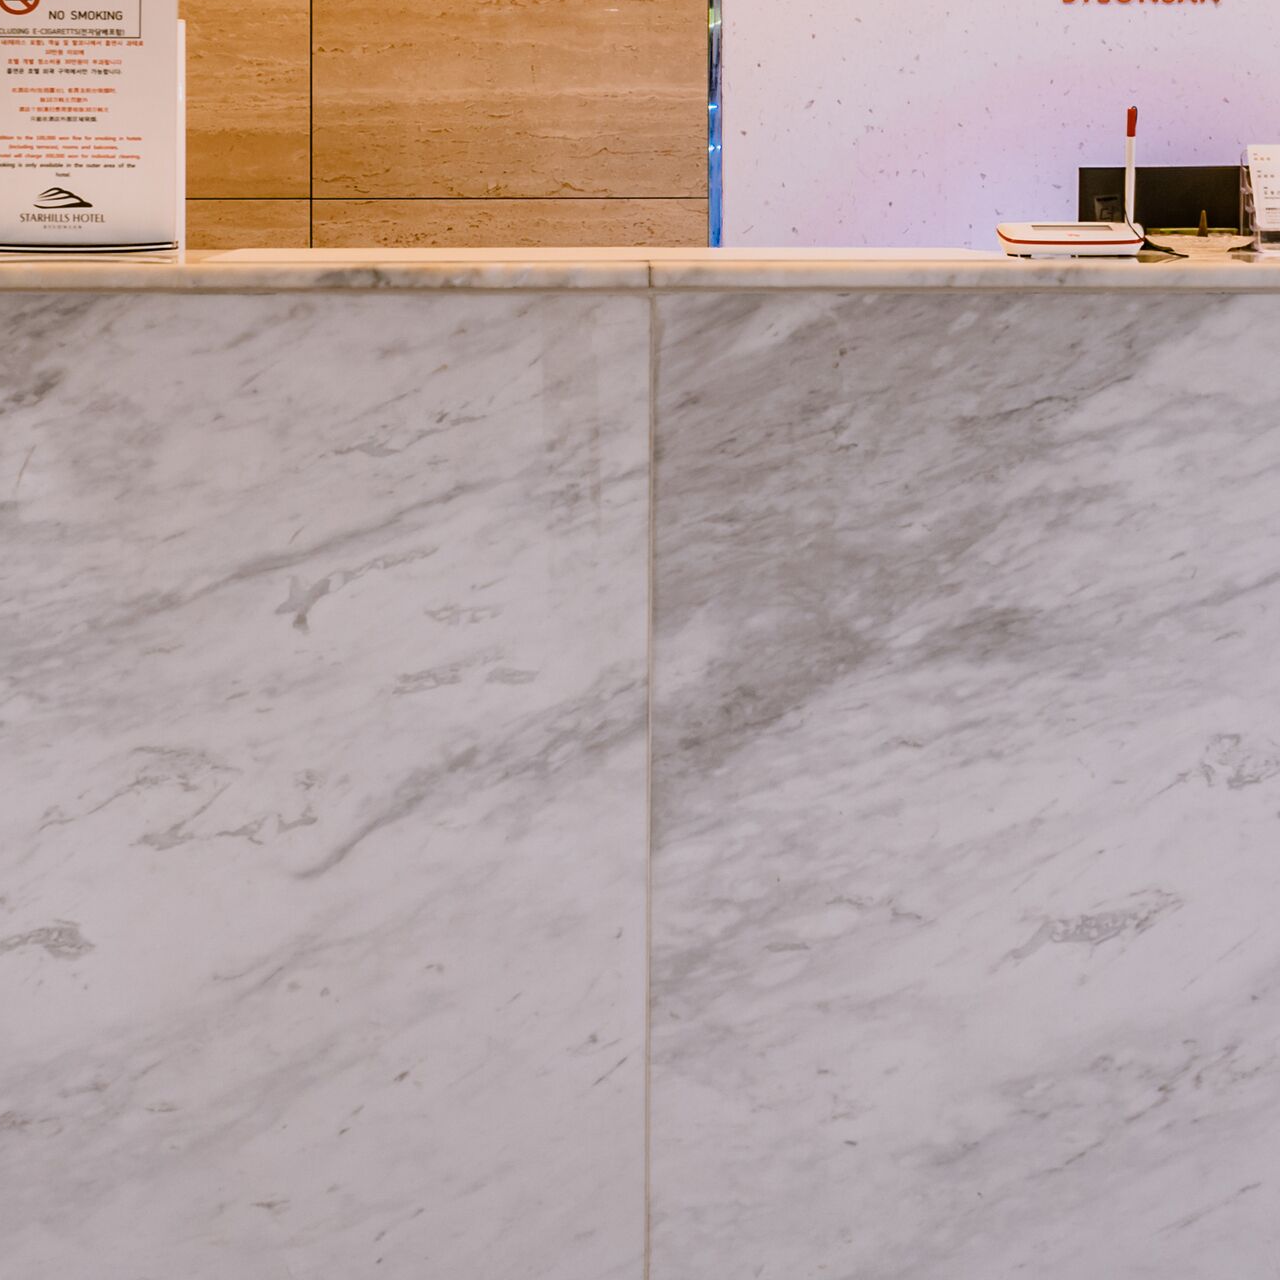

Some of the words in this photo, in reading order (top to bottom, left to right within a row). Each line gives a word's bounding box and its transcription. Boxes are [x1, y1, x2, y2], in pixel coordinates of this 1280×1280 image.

[48, 11, 65, 21] NO
[70, 11, 123, 21] SMOKING
[19, 213, 70, 223] STARHILLS
[72, 213, 106, 223] HOTEL
